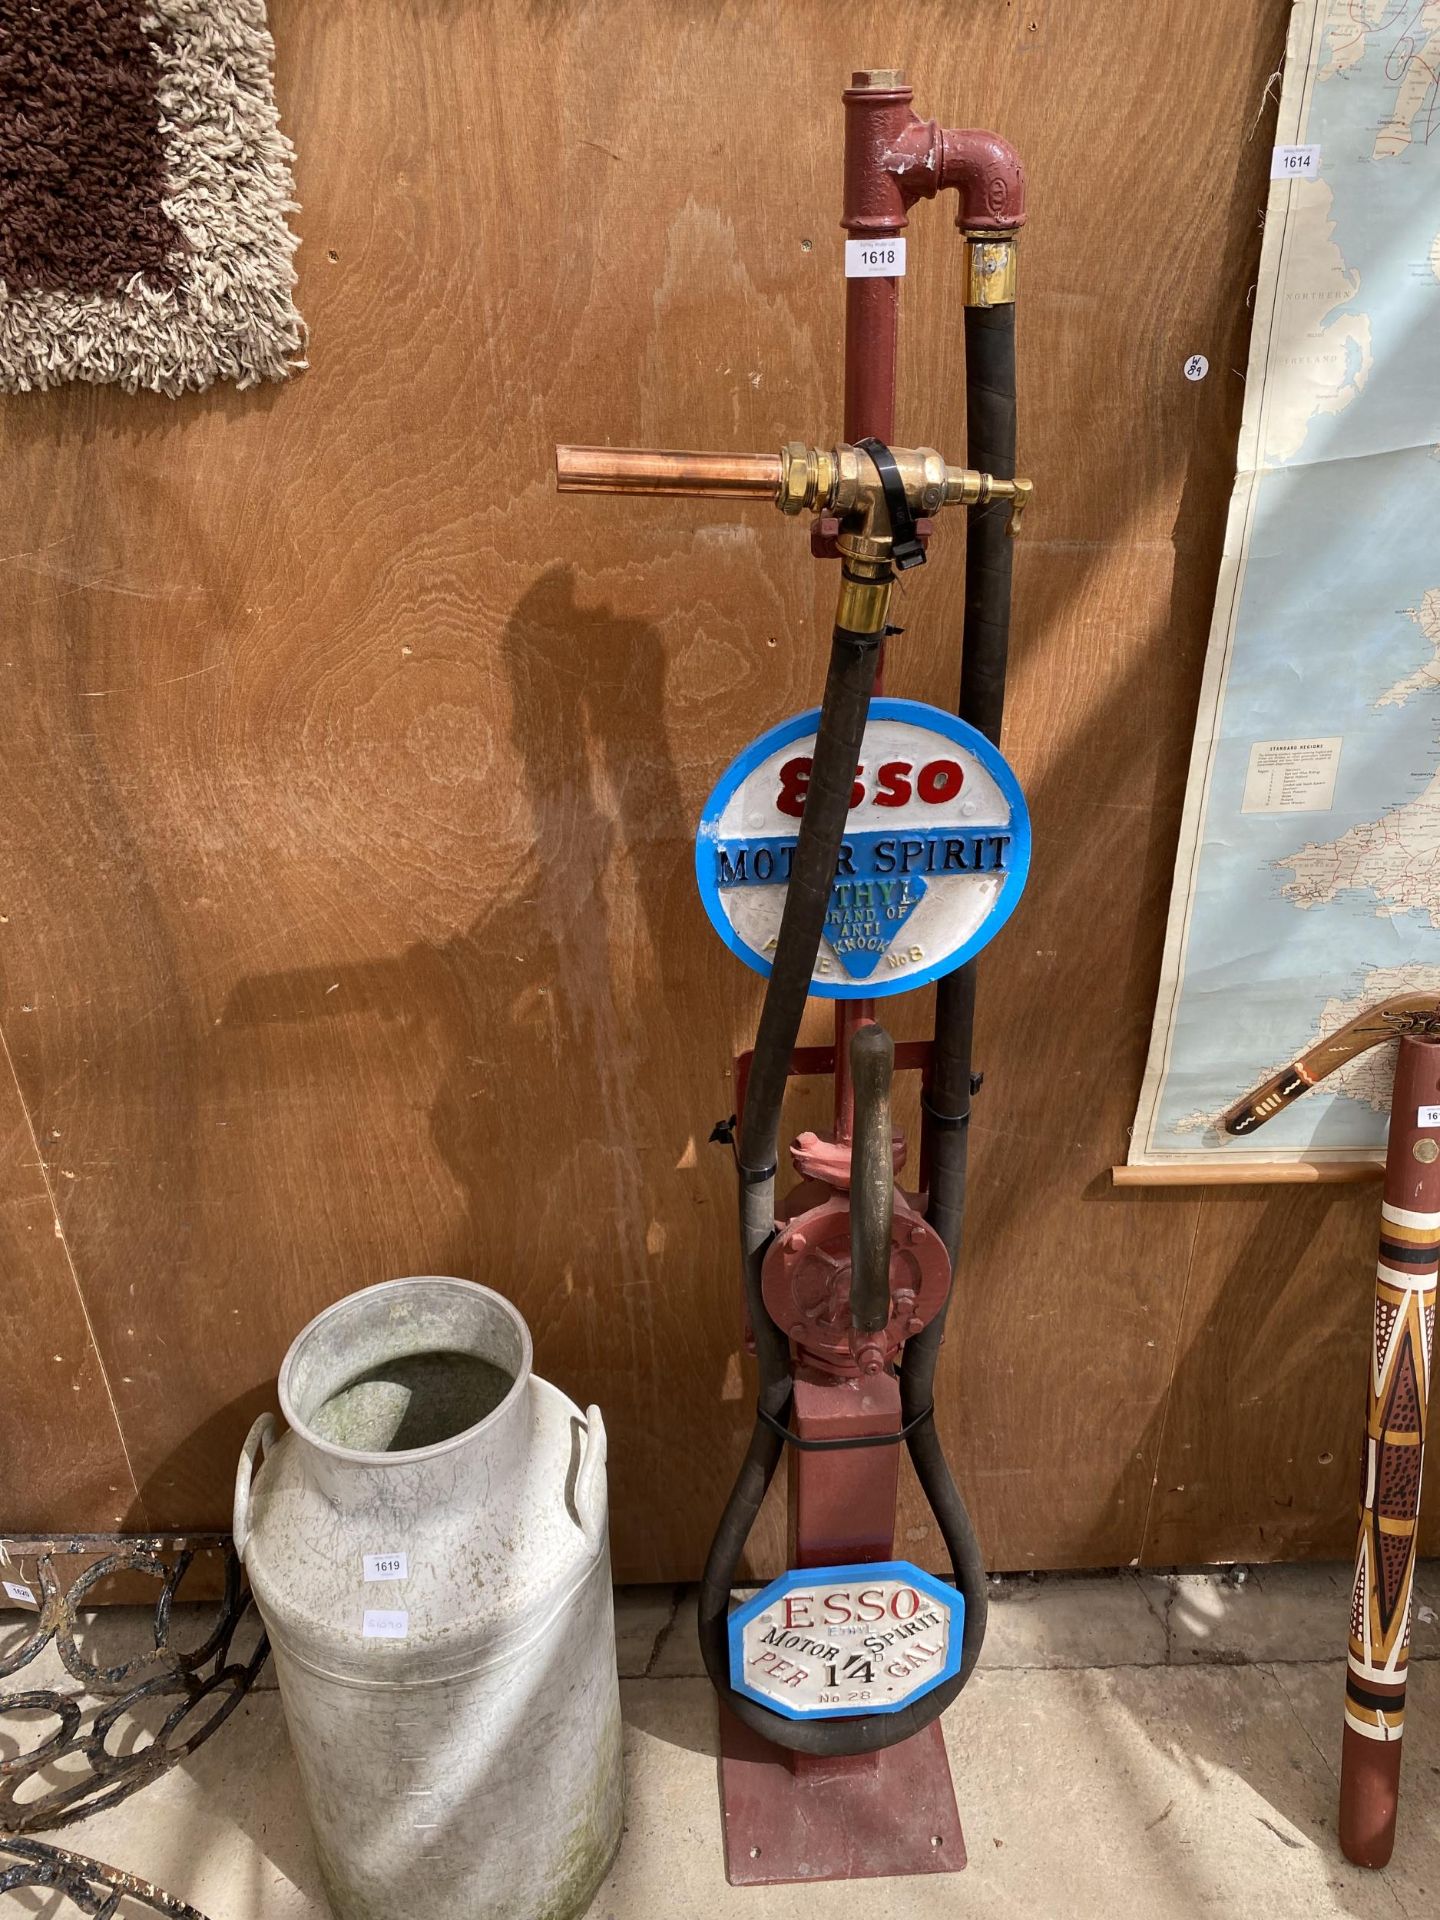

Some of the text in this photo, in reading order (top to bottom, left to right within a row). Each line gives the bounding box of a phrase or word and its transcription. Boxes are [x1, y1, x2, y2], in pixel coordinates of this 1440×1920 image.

[1284, 155, 1311, 168] 1614
[861, 250, 895, 264] 1618
[719, 836, 1011, 883] MOTR SPIRIT
[833, 879, 914, 909] THYL
[886, 905, 909, 920] OF
[841, 923, 881, 937] ANTI
[833, 937, 891, 956] KNOCK
[375, 1560, 400, 1573] 1619
[783, 1588, 920, 1629] ESSO
[761, 1611, 942, 1662] MOTOR SPIRIT
[750, 1651, 810, 1688] PER
[819, 1691, 871, 1703] No 28
